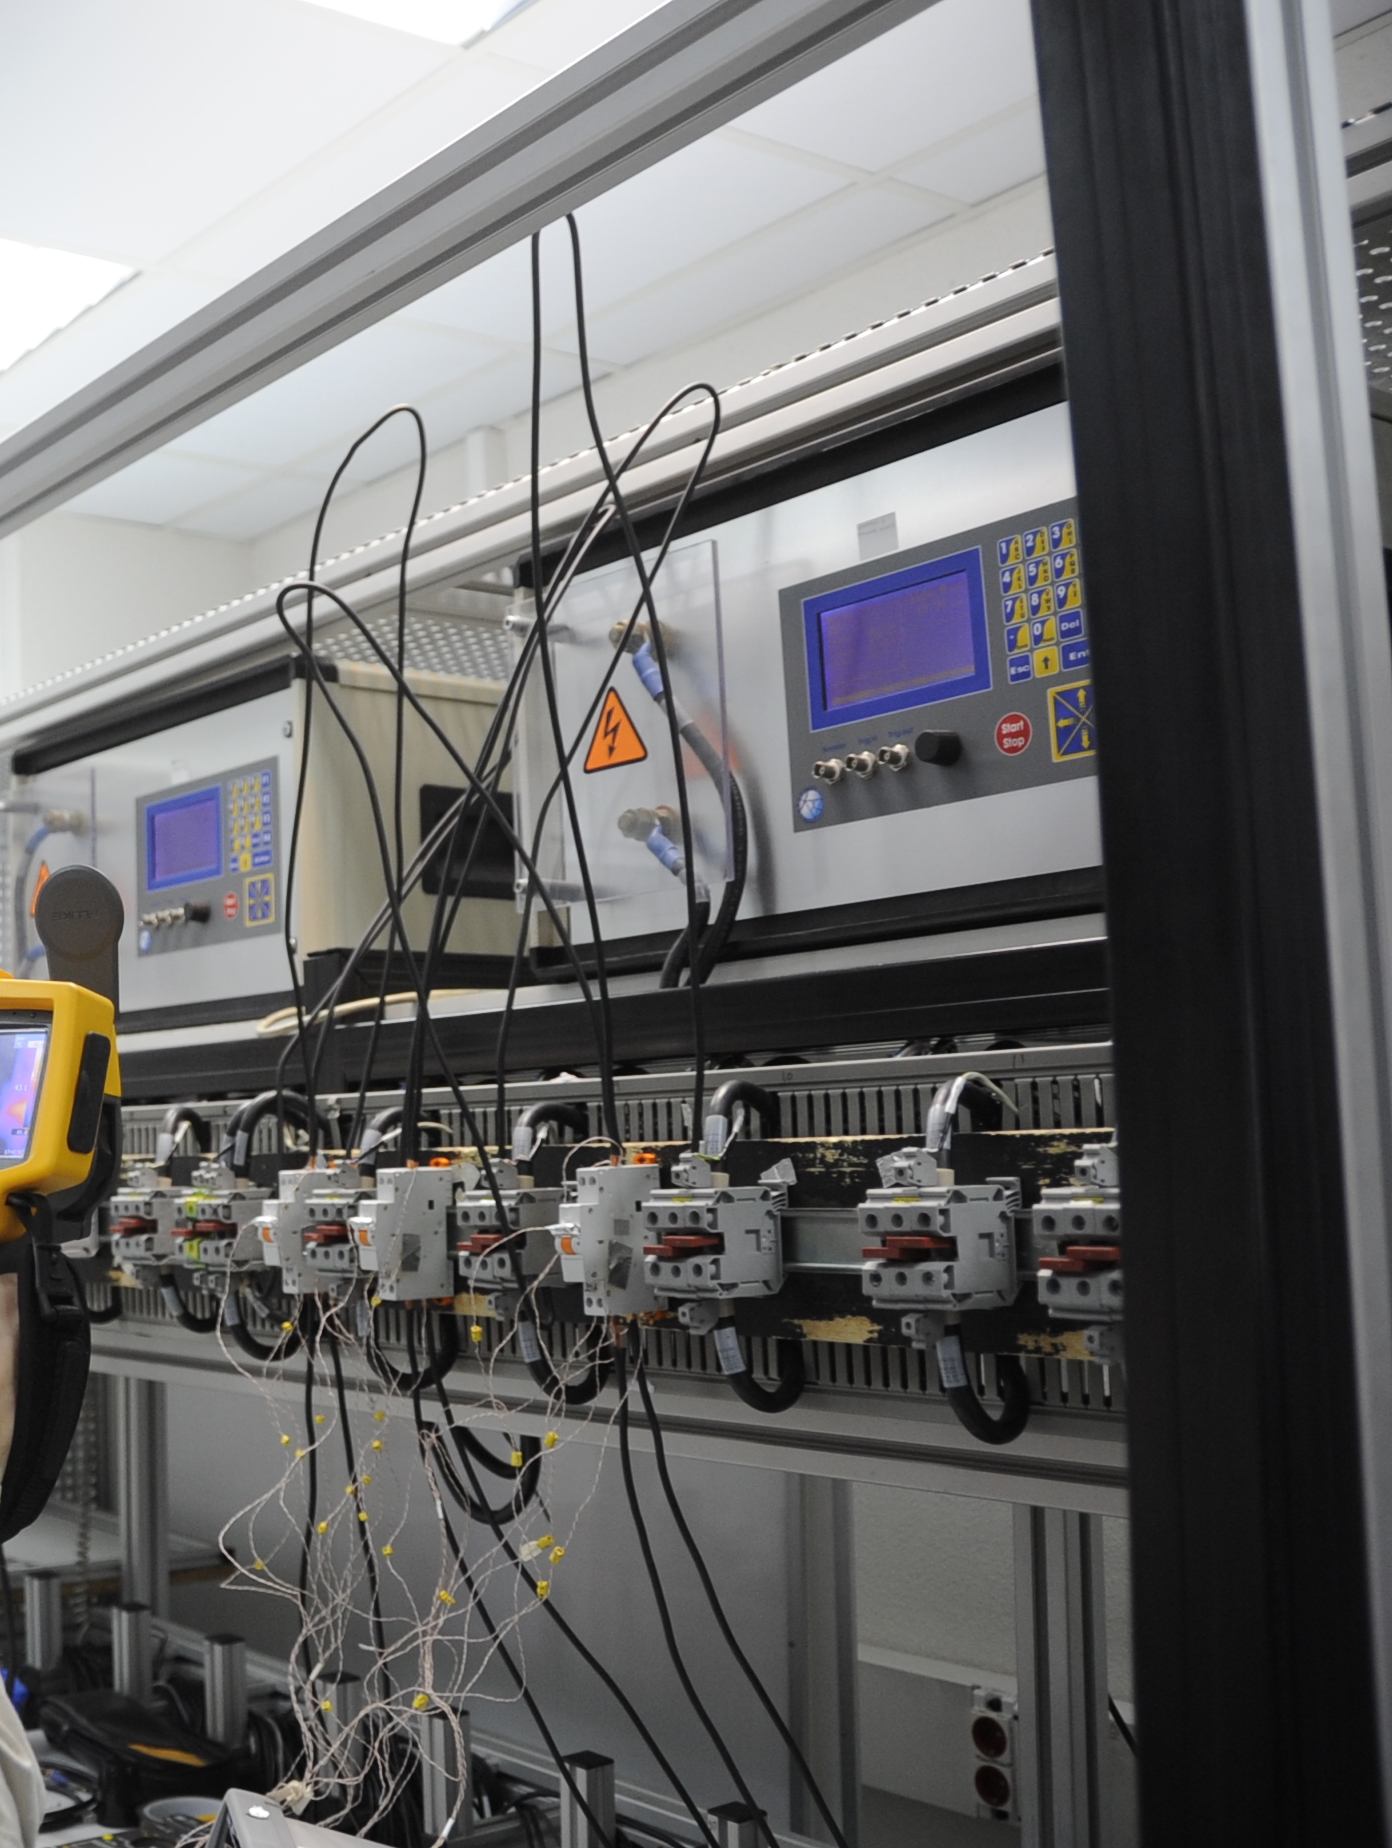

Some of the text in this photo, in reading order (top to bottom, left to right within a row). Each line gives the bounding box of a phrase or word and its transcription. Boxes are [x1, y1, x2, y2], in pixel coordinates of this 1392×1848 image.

[1052, 526, 1060, 538] 3
[1026, 534, 1034, 546] 2
[1000, 542, 1007, 554] 1
[1055, 556, 1063, 568] 6
[1028, 563, 1036, 576] 5
[1003, 571, 1011, 582] 4
[1057, 586, 1065, 598] 9
[1031, 593, 1039, 606] 8
[1005, 600, 1013, 612] 7
[1033, 623, 1042, 635] 0
[1061, 619, 1080, 631] Del
[1010, 665, 1030, 675] Esc
[1001, 720, 1024, 734] Start
[1003, 736, 1025, 749] Stop
